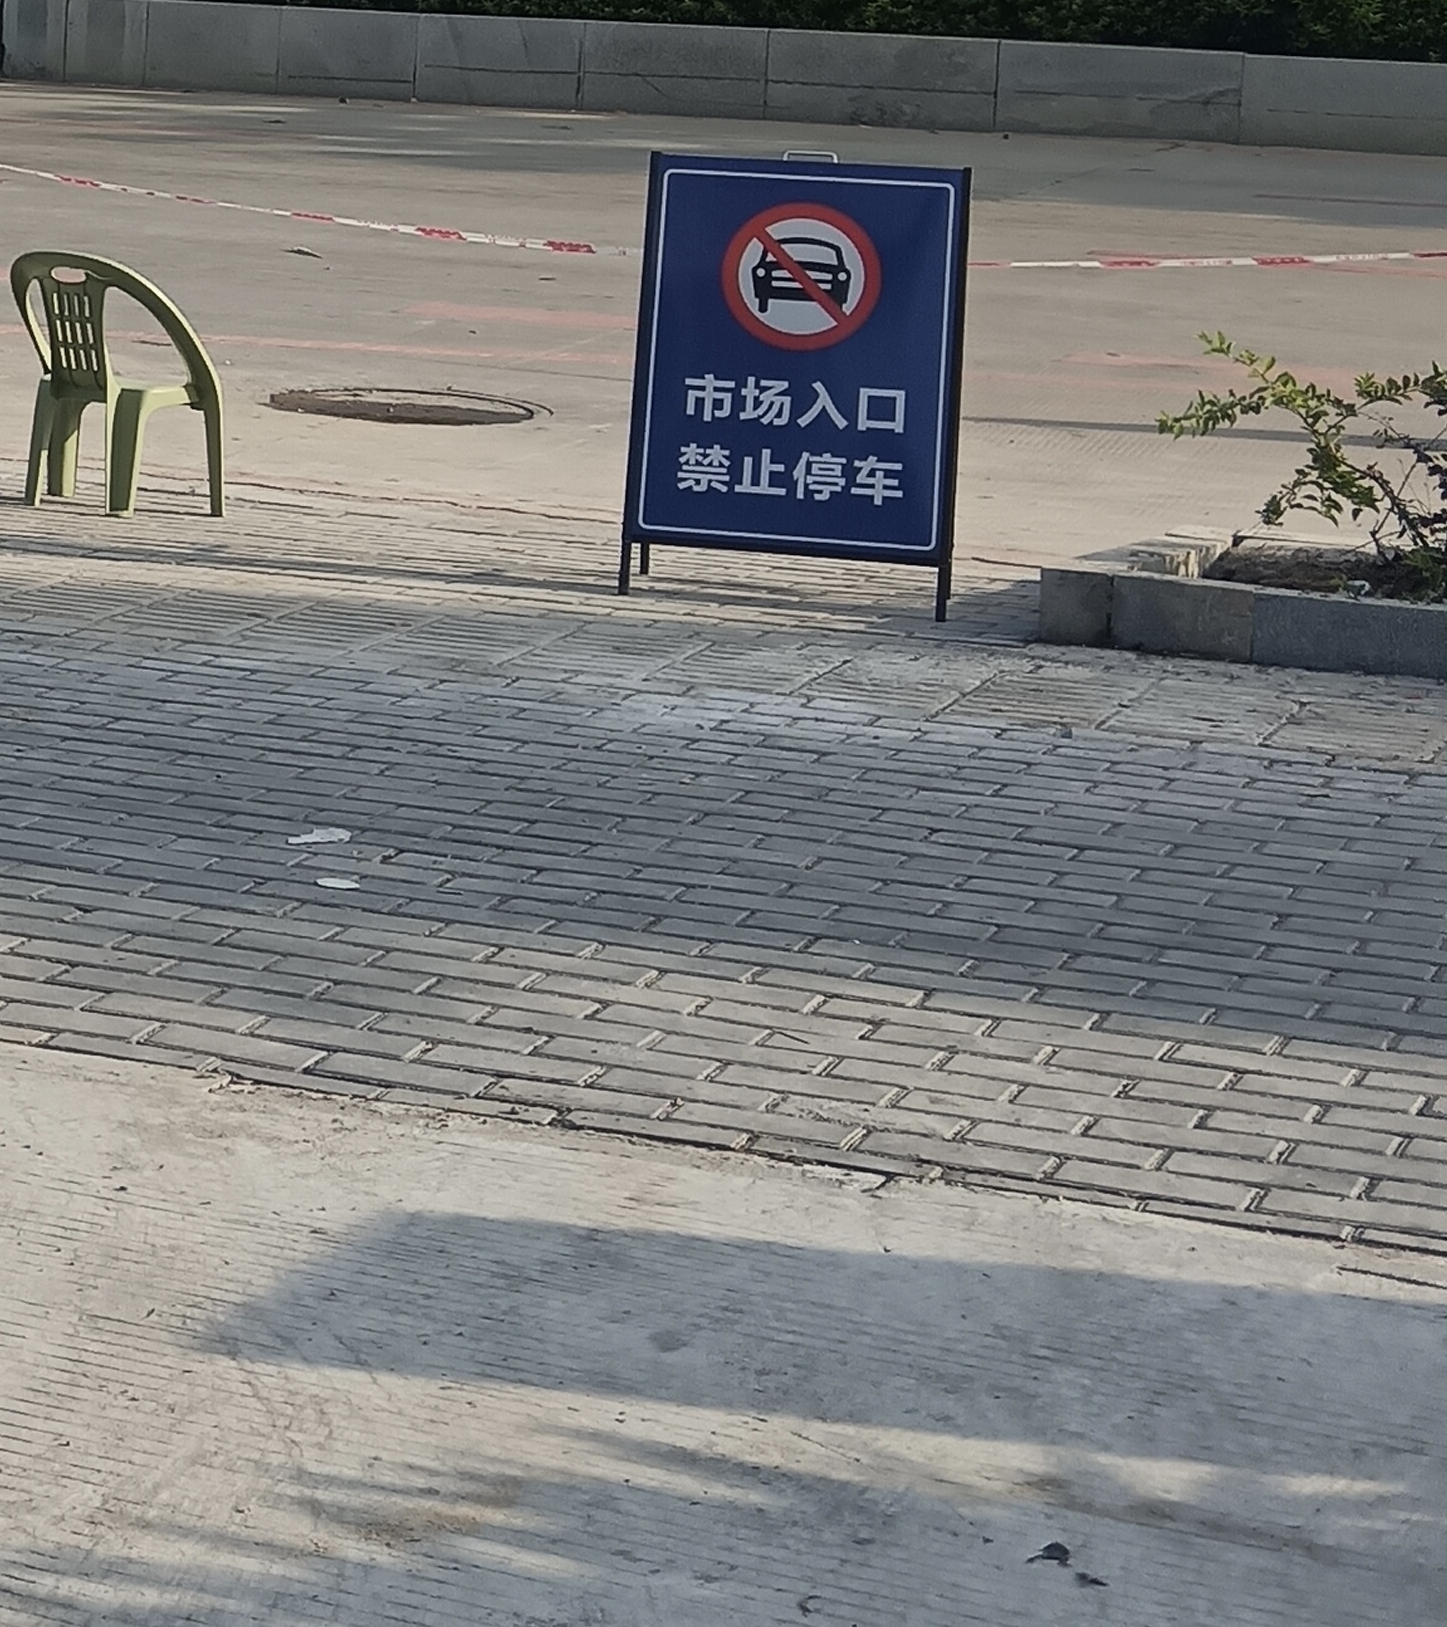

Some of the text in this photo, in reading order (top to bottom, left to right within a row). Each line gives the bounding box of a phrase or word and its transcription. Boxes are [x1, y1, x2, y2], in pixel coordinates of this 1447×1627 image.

[684, 374, 906, 433] 市场入口
[677, 443, 903, 505] 禁止停车
